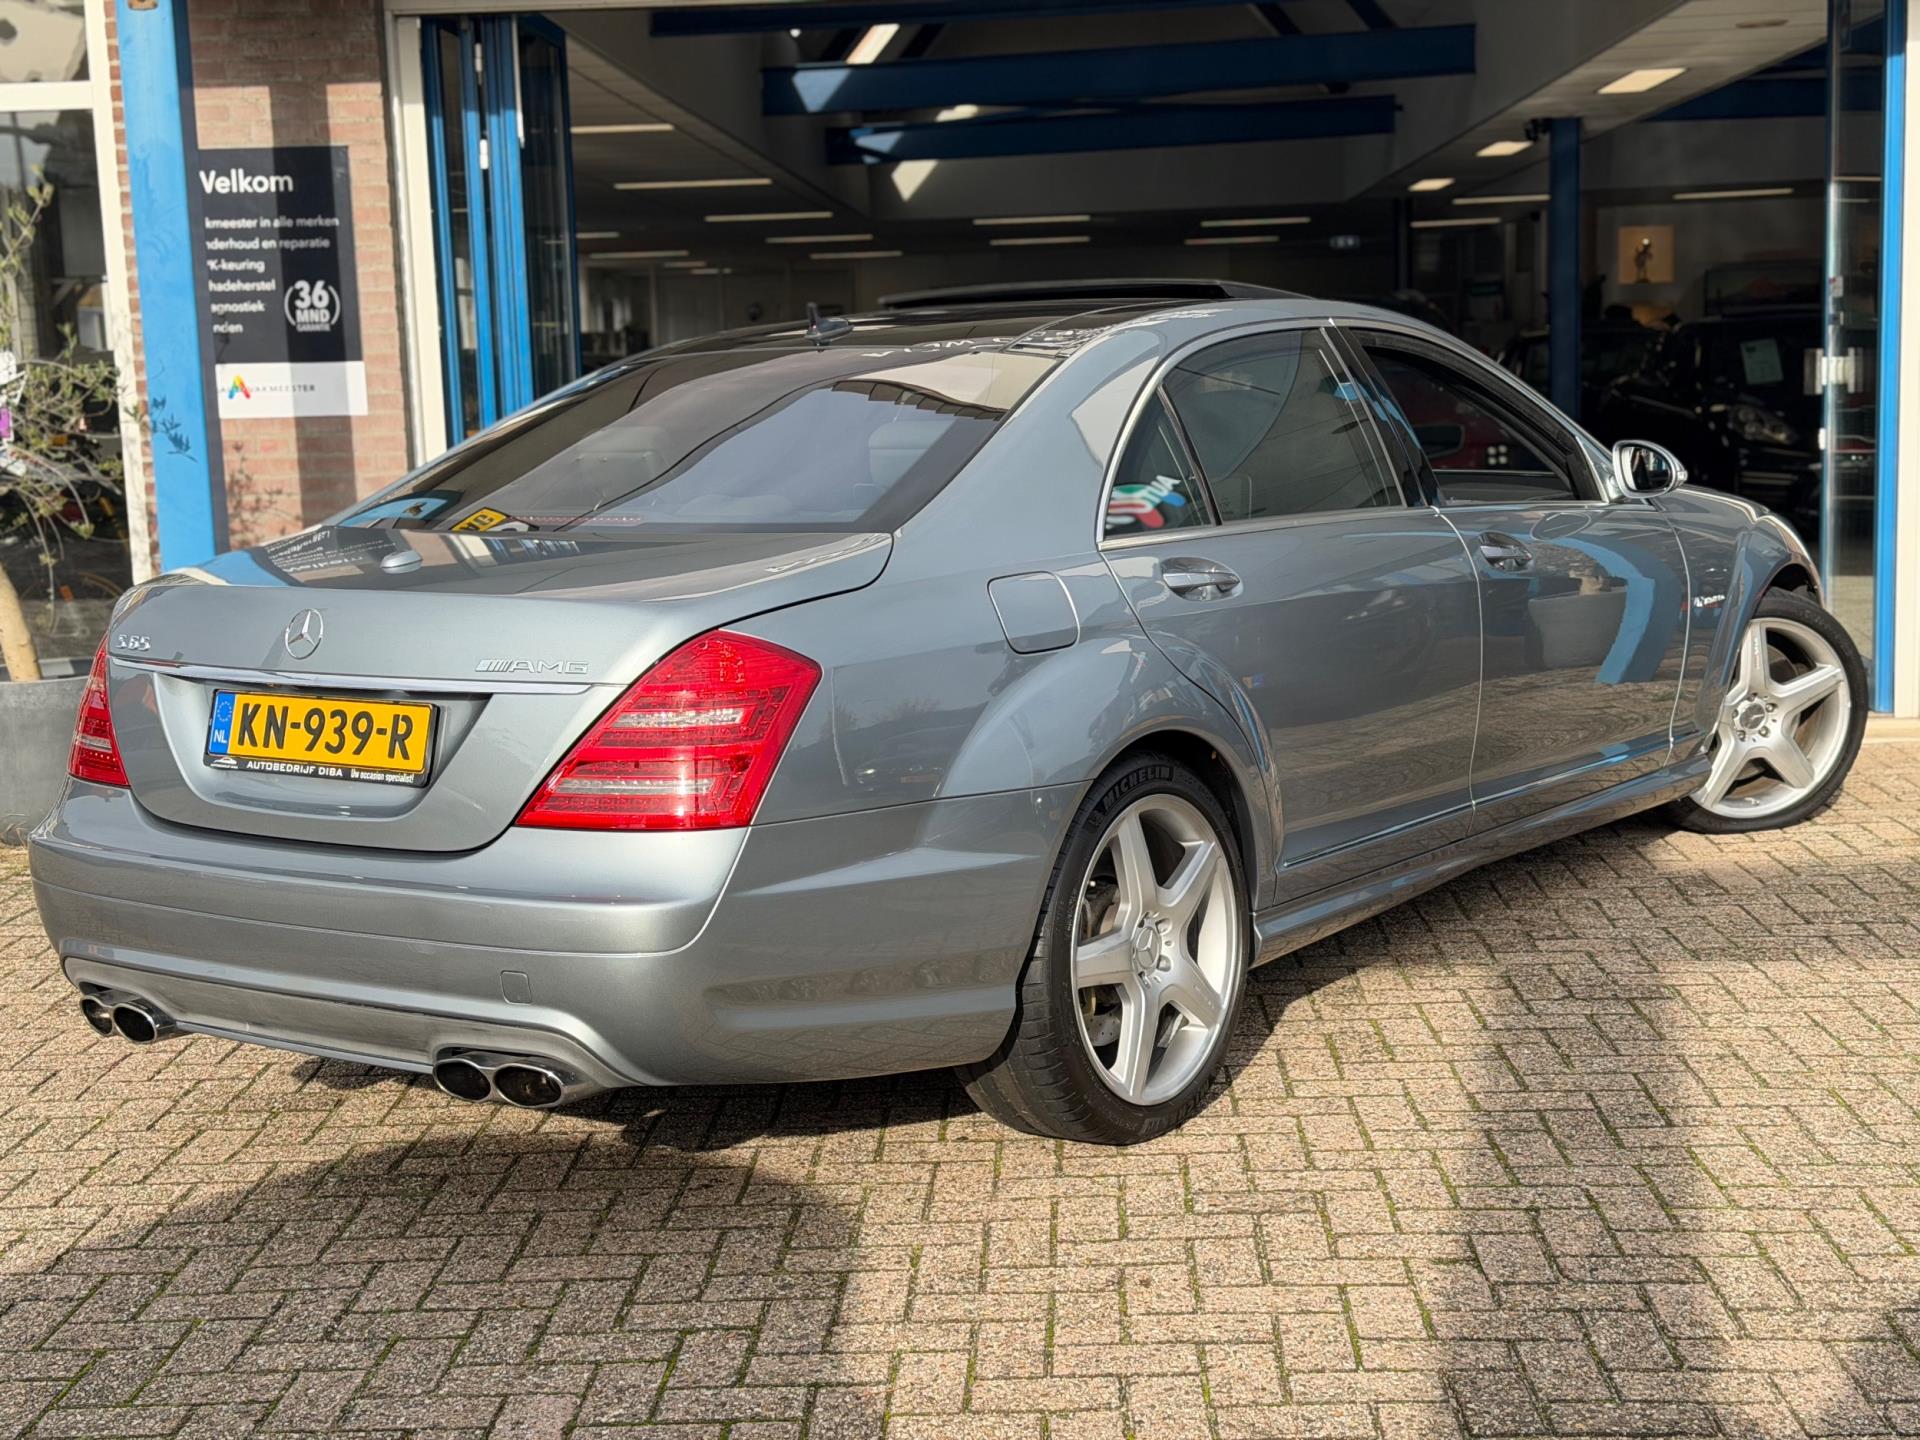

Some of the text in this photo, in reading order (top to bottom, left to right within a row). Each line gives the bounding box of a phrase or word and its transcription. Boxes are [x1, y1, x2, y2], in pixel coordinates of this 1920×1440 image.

[259, 216, 271, 228] in
[273, 215, 294, 228] alle
[296, 214, 339, 227] merken
[261, 240, 277, 249] en
[279, 237, 330, 252] reparatie
[293, 279, 330, 309] 36
[295, 308, 331, 323] MND
[509, 660, 589, 674] AMG
[213, 729, 228, 744] NL
[237, 703, 413, 760] KN-939-R
[246, 760, 316, 774] AUTOBEDRIJF
[318, 767, 343, 777] DIBA
[1102, 767, 1170, 811] MICHELIN
